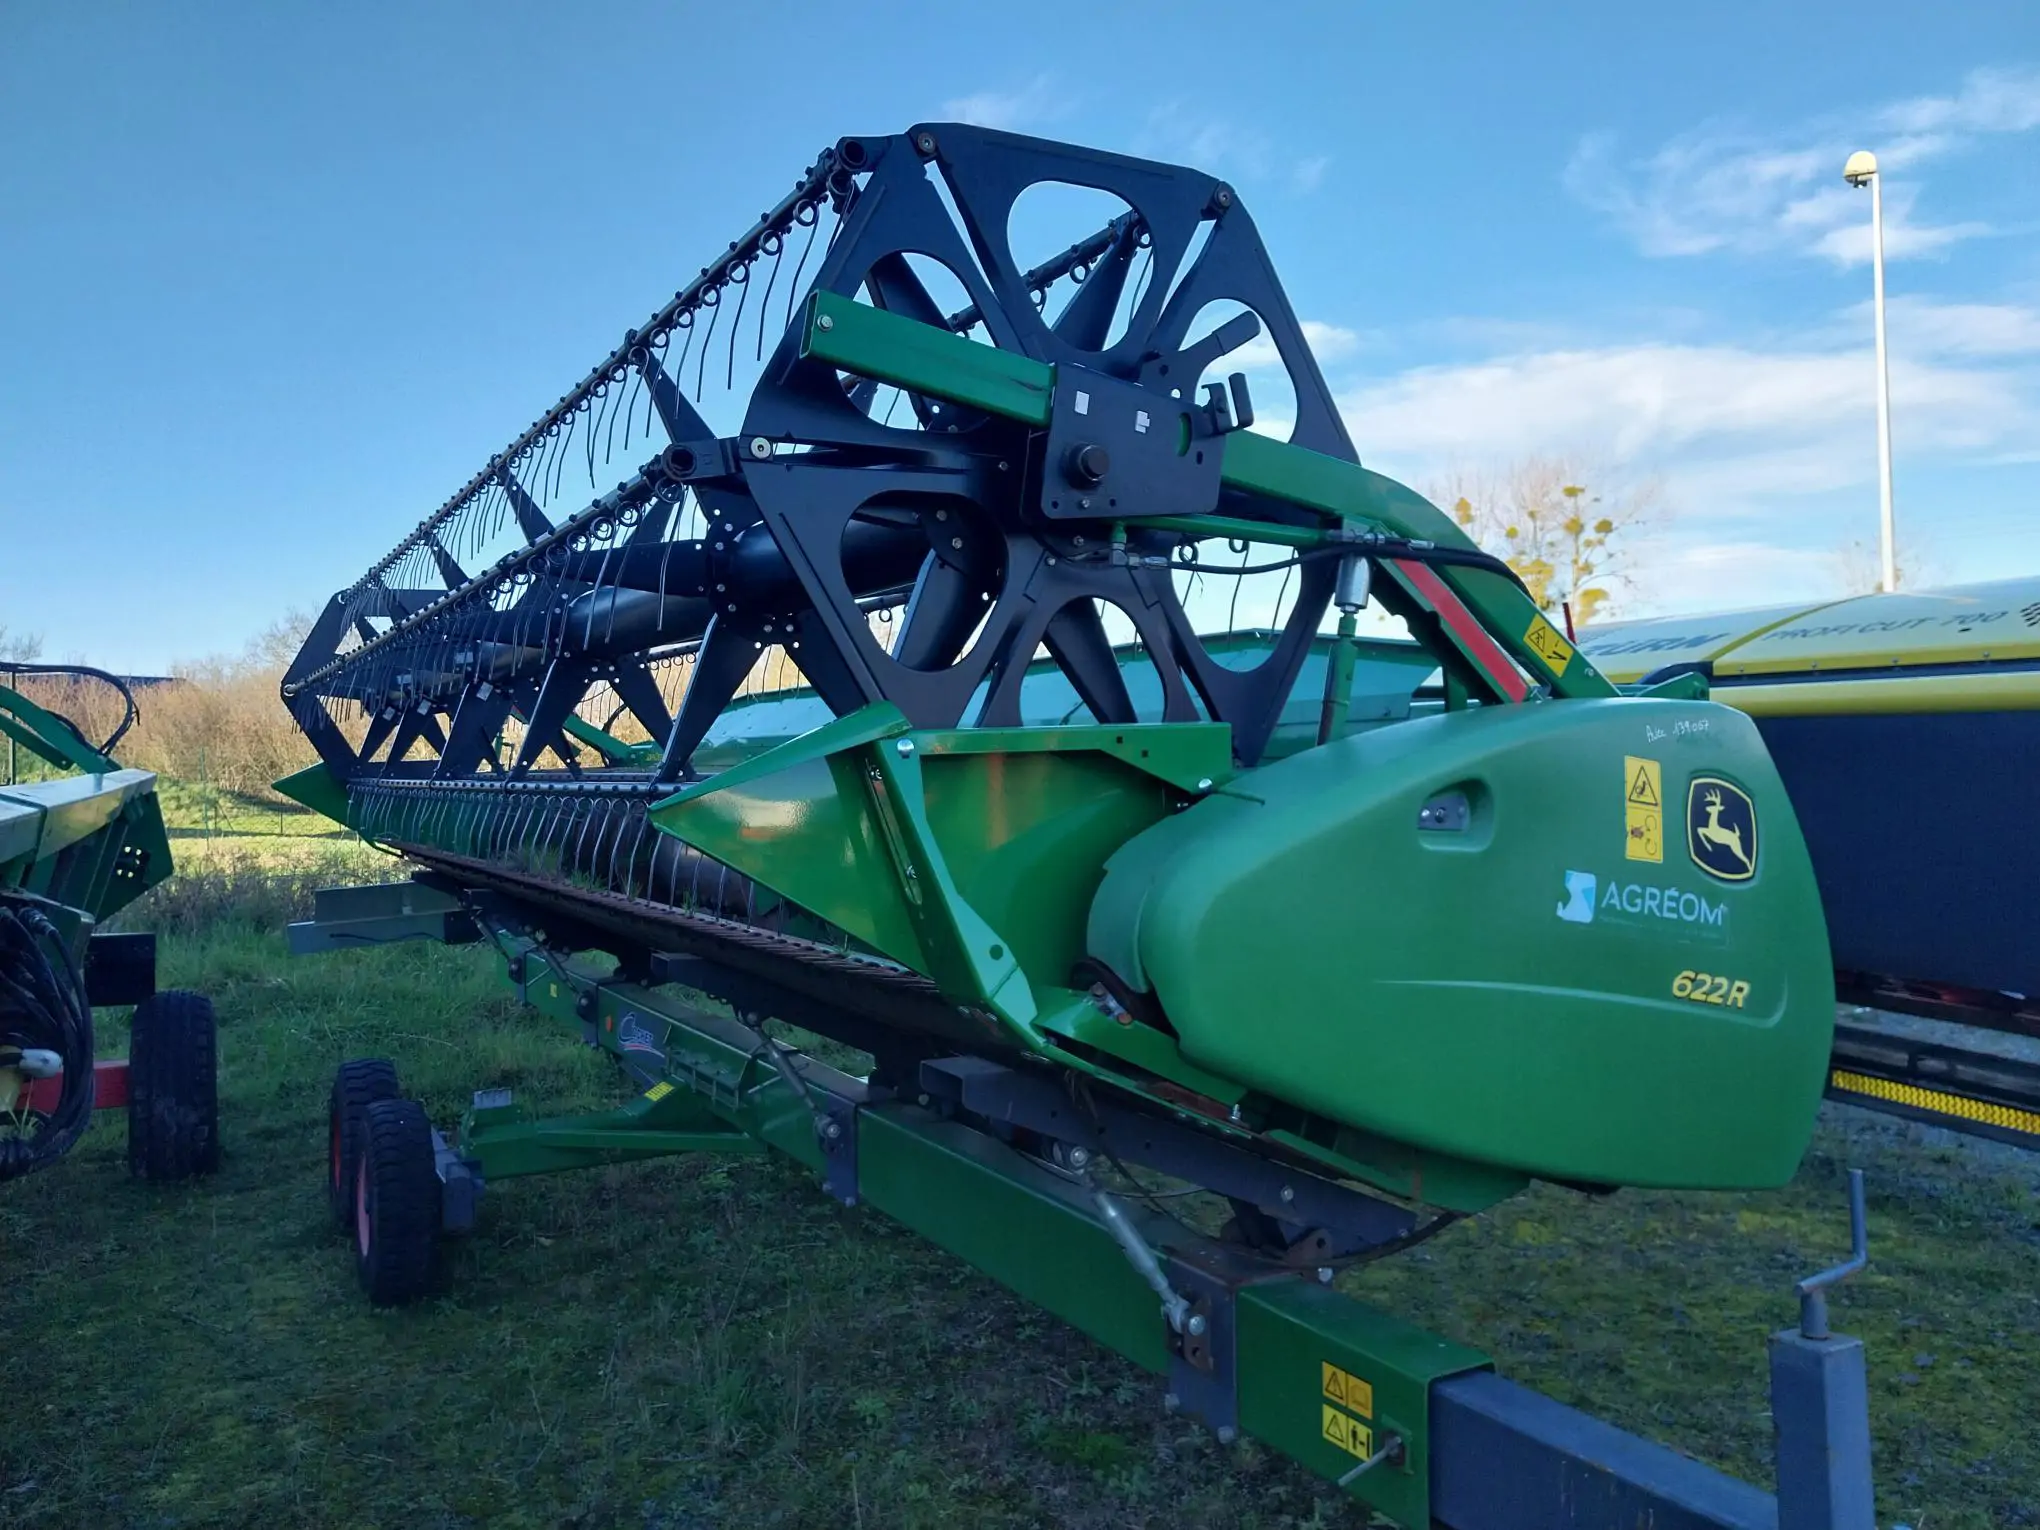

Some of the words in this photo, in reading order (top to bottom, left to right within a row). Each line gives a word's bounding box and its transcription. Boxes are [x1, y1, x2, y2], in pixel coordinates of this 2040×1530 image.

[1857, 616, 1938, 634] CUT
[1601, 881, 1724, 926] AGRÉOM
[1672, 969, 1750, 1009] 622R
